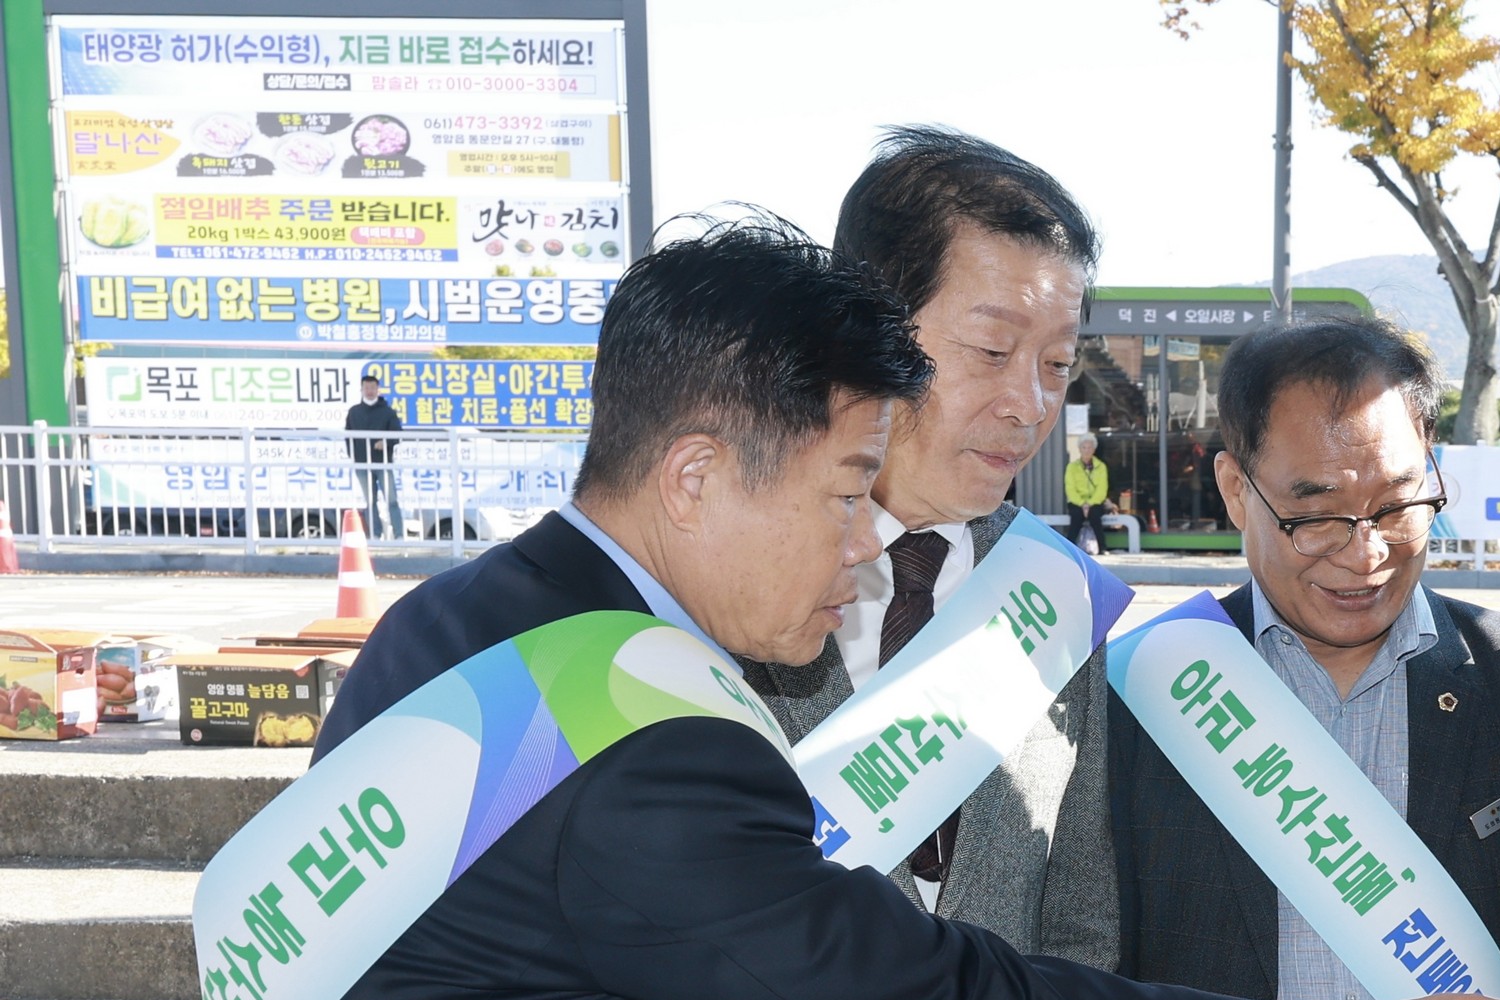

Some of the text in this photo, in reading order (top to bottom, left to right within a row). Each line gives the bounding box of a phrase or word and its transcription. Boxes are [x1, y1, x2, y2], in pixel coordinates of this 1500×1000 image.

[84, 33, 594, 68] 태양광 허가(수익형), 지금 바로 접수하세요!
[266, 74, 348, 90] 상담/문의/접수
[446, 77, 579, 92] 010-3000-3304
[423, 115, 543, 130] 061)473-3392
[74, 132, 163, 156] 달나산
[515, 134, 530, 145] 27
[160, 197, 450, 223] 절임배추 주문 받습니다.
[561, 207, 619, 231] 김치
[187, 226, 346, 242] 20kg 1박스 43,900원
[90, 276, 210, 321] 비급여
[215, 277, 297, 322] 없는
[302, 277, 397, 326] 병원,
[1184, 309, 1235, 324] 오일시장
[146, 366, 350, 404] 목포 더조은내과
[415, 398, 453, 425] 혈관
[207, 683, 225, 696] 영암
[189, 697, 250, 719] 꿀고구마
[1170, 659, 1257, 754] 우리
[1231, 742, 1417, 917] 농수산물,
[286, 787, 406, 918] 우리
